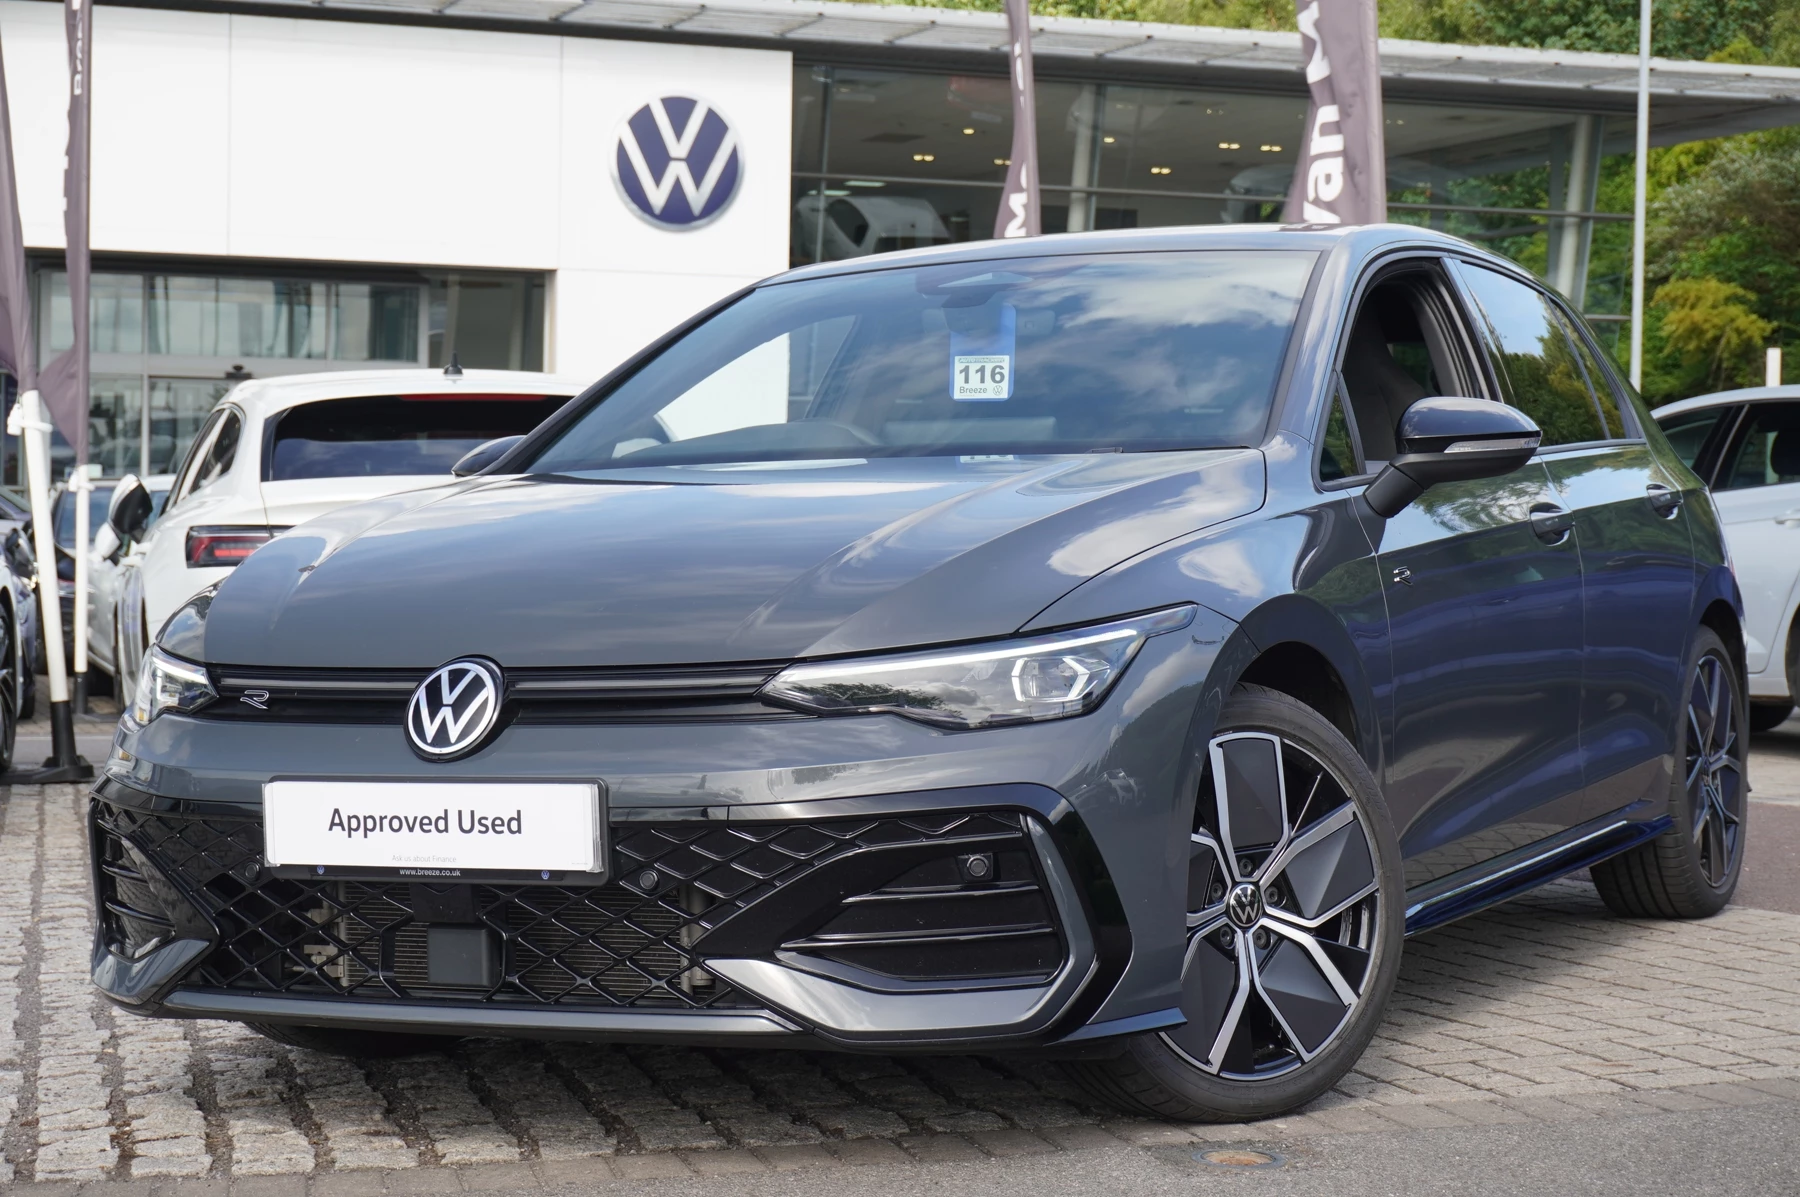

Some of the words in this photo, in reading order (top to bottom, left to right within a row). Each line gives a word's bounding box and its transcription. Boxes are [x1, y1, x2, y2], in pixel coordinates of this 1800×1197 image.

[614, 94, 741, 220] VW
[959, 364, 1005, 385] 116
[959, 386, 988, 394] Breeze
[414, 668, 494, 745] VW
[328, 807, 449, 839] Approved
[457, 809, 522, 835] Used
[391, 854, 402, 862] Ask
[413, 855, 431, 863] about
[432, 855, 457, 863] Finance
[399, 867, 461, 876] www.breeze.co.uk
